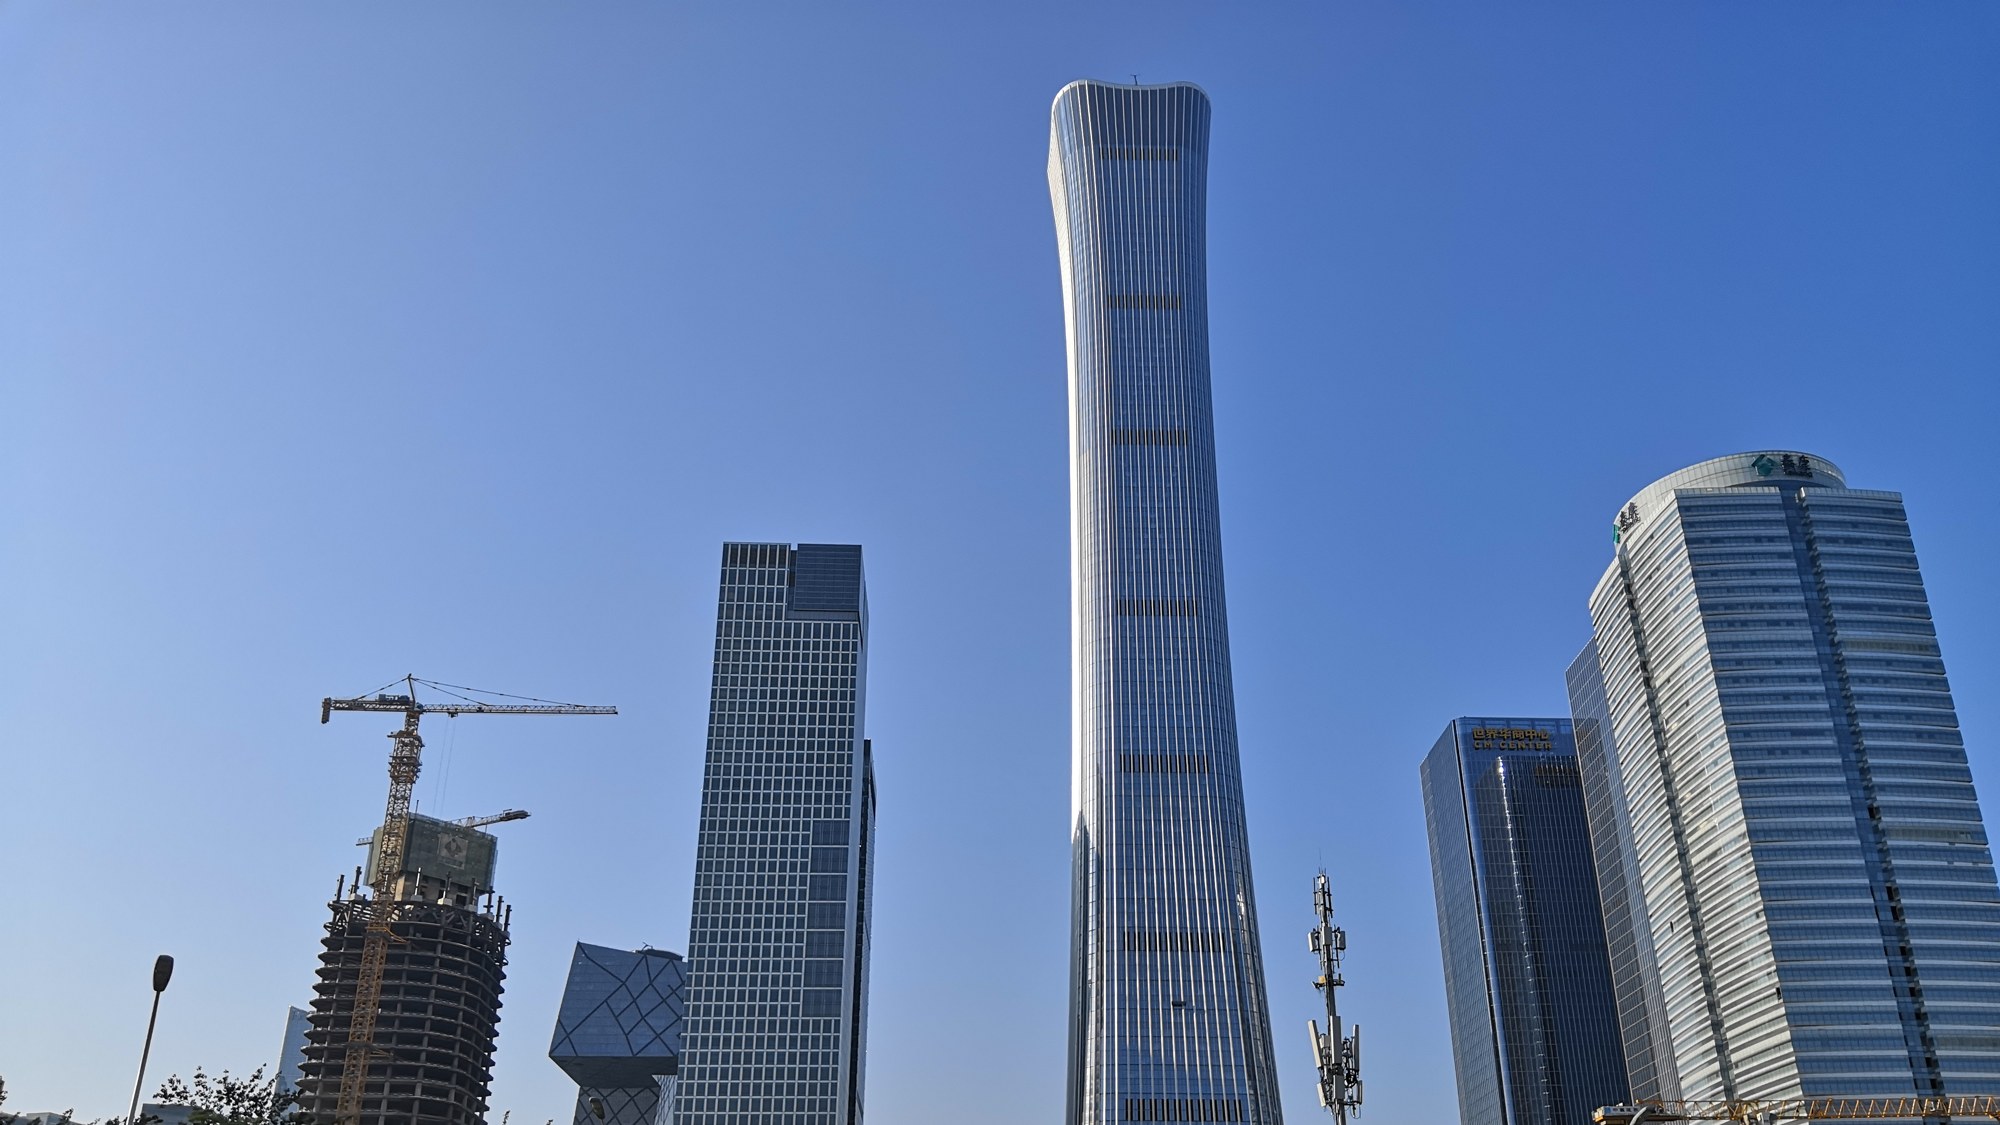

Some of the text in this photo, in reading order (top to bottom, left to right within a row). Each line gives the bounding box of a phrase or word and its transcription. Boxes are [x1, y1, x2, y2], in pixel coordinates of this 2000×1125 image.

[1473, 728, 1549, 740] 世界华商中心
[1474, 740, 1552, 750] CM CENTER
